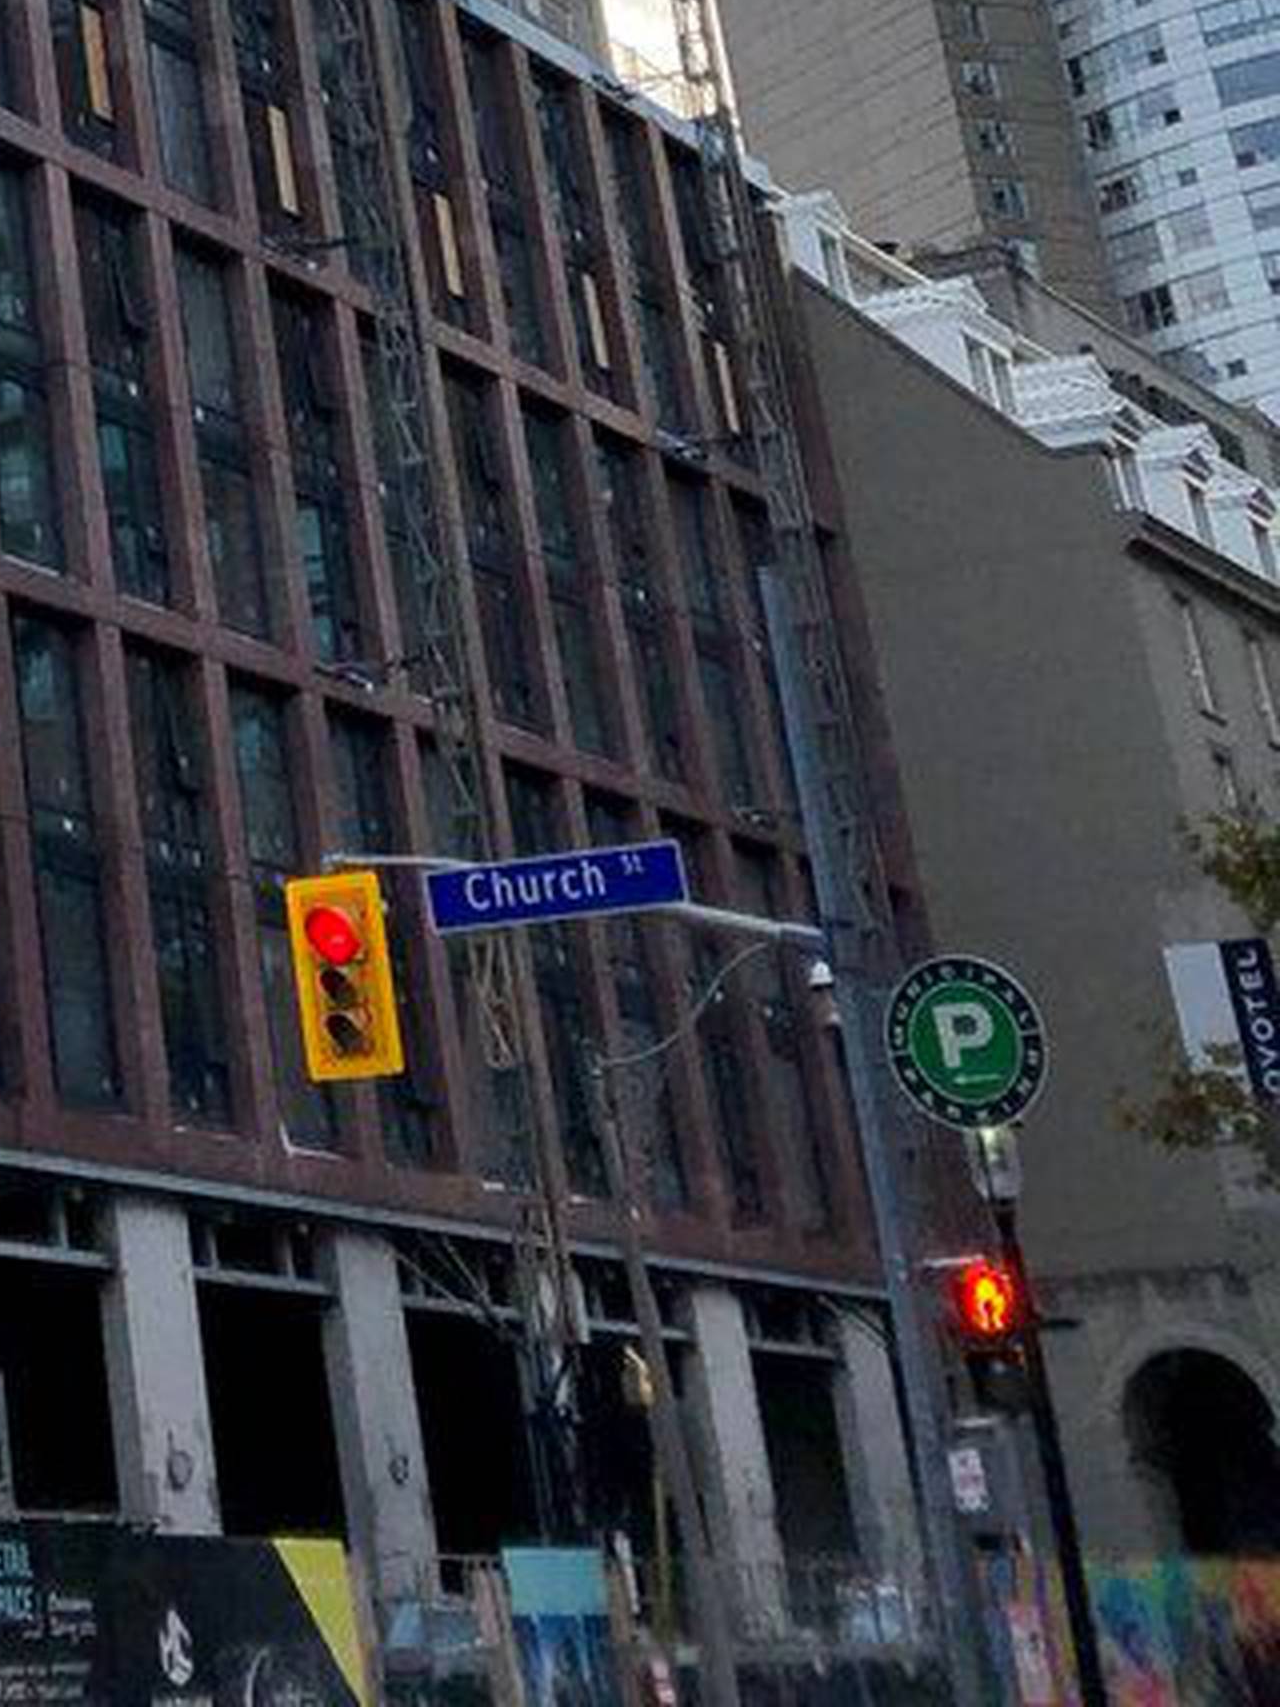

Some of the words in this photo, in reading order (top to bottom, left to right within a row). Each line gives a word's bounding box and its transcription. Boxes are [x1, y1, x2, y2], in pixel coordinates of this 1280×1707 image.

[464, 859, 607, 911] Church
[893, 964, 1032, 1047] MUNICIPAL
[932, 1001, 994, 1069] P
[1238, 947, 1280, 1094] OVOTEL
